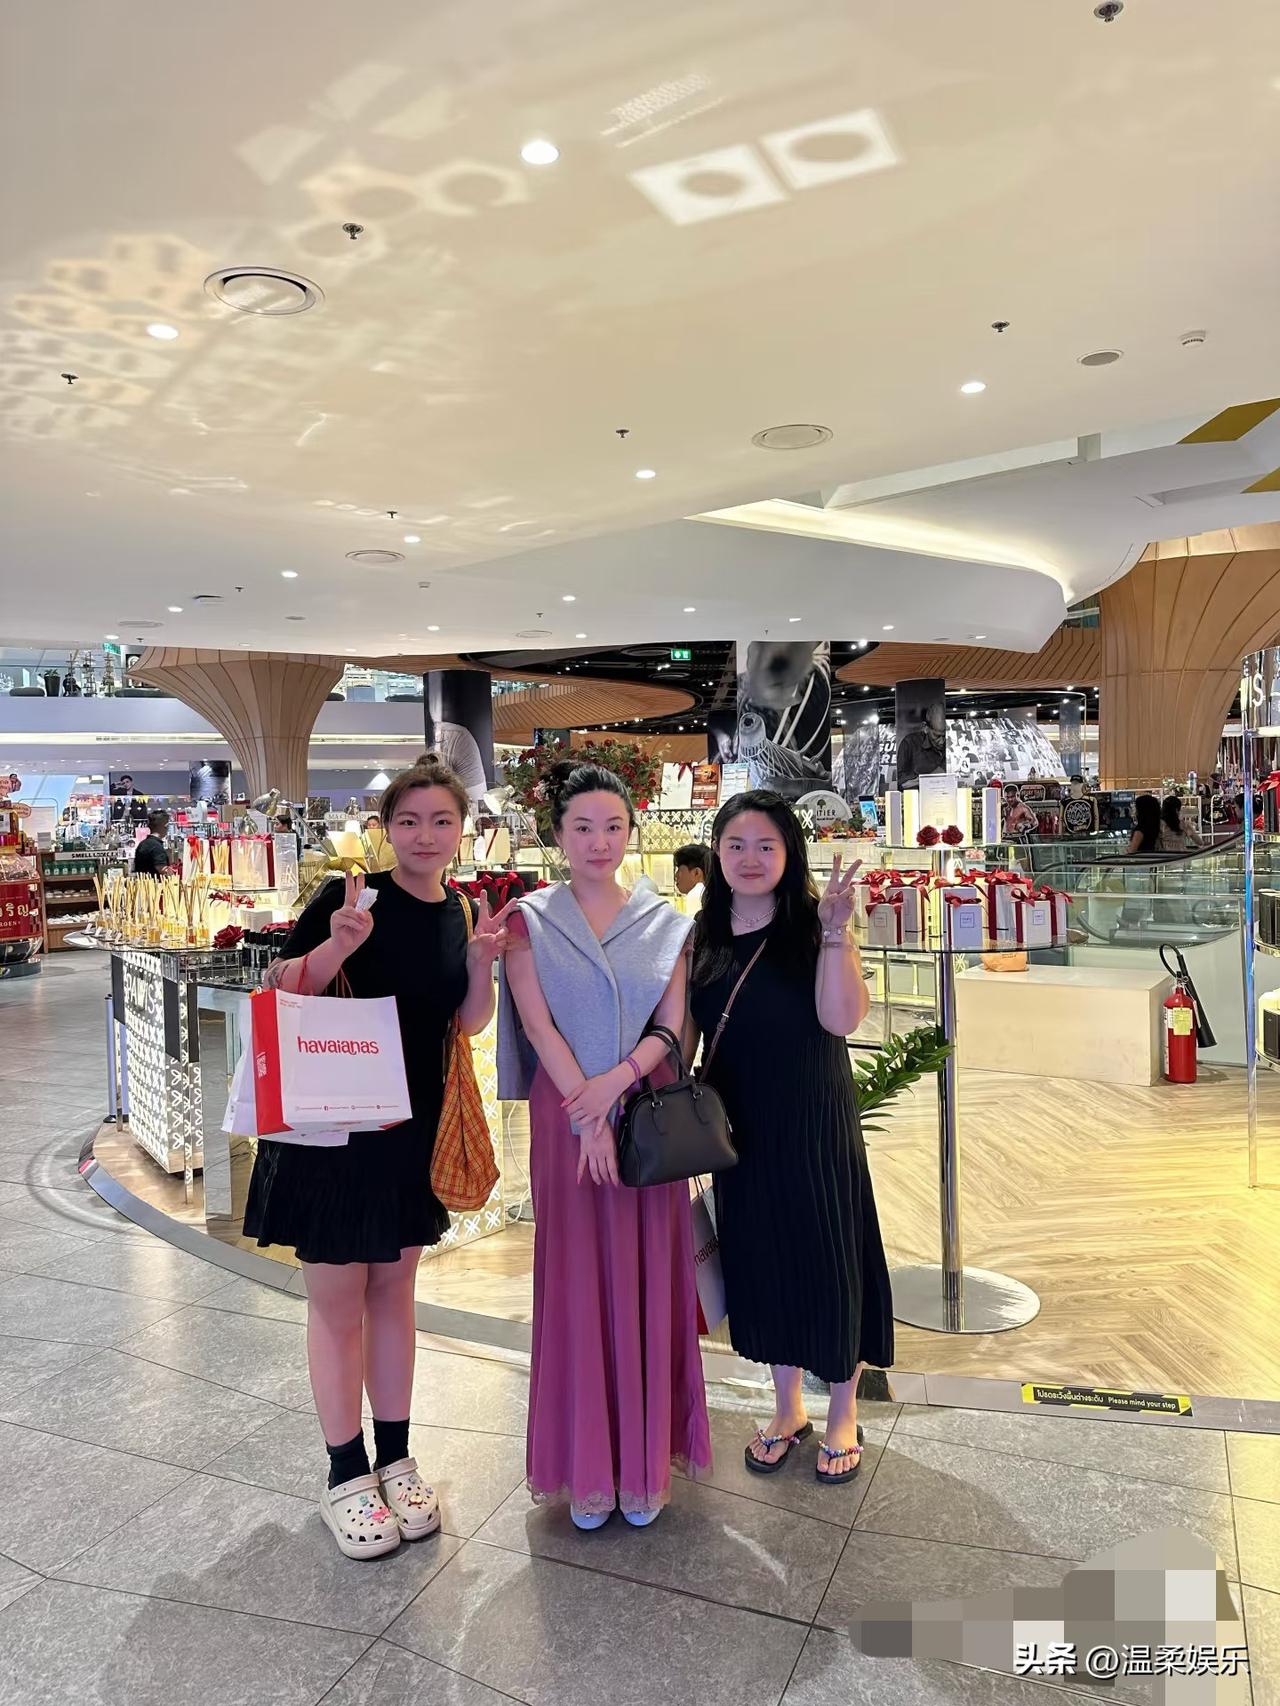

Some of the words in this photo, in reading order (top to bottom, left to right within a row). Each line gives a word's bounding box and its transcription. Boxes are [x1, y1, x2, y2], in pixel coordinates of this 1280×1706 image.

[297, 1035, 379, 1056] havaianas
[1107, 1396, 1129, 1405] Please
[1129, 1399, 1146, 1407] mind
[1161, 1402, 1176, 1410] step
